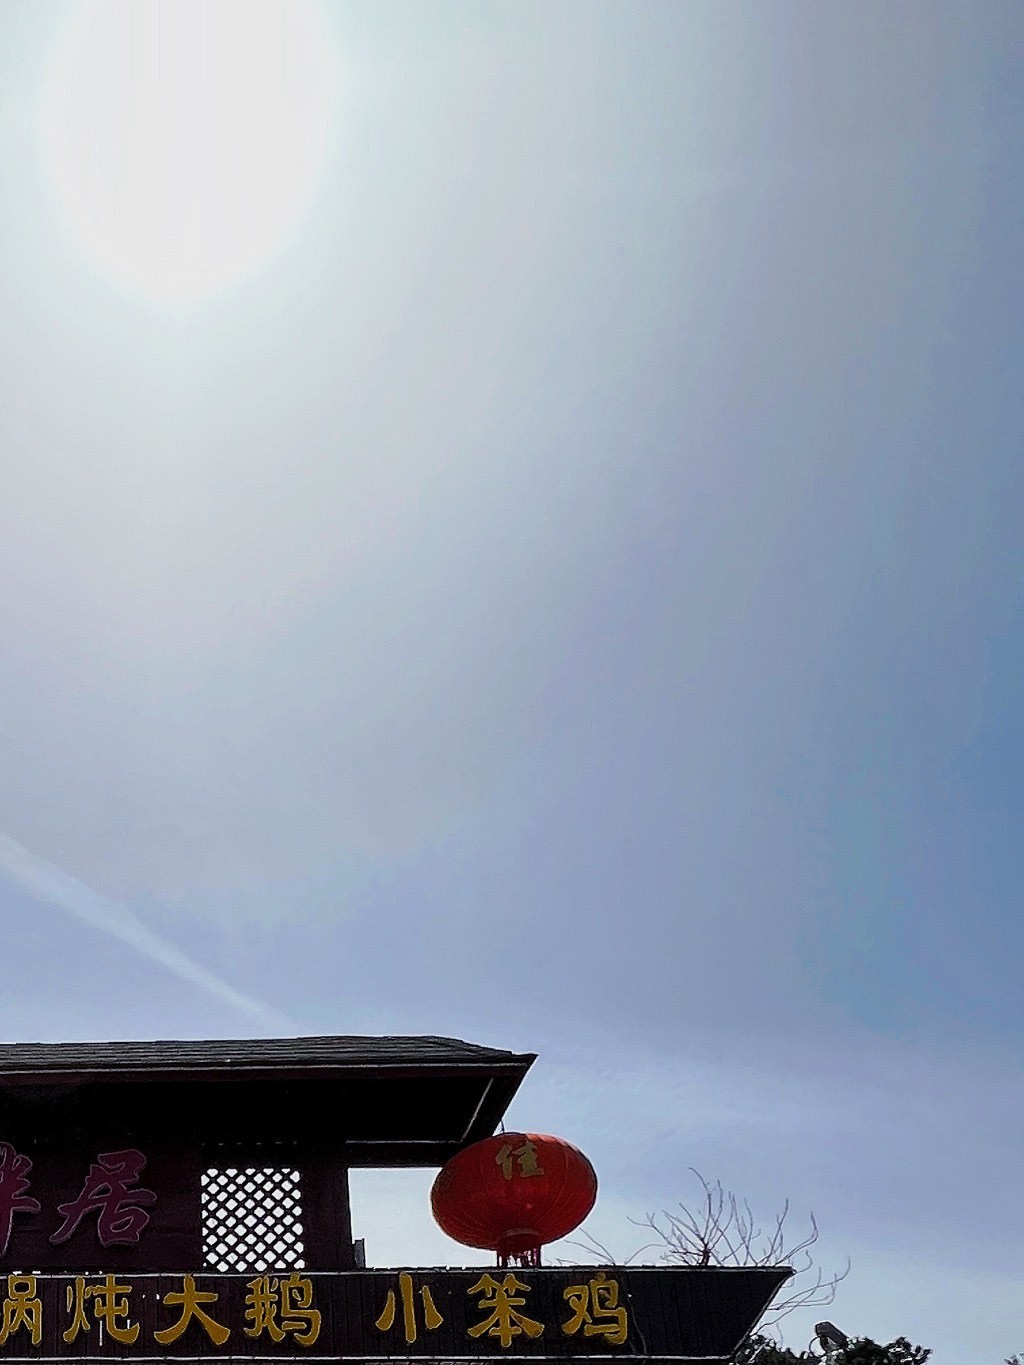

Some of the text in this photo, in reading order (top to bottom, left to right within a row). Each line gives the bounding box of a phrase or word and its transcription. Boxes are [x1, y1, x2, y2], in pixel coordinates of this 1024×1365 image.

[495, 1140, 545, 1181] 佳
[375, 1273, 629, 1347] 小笨鸡
